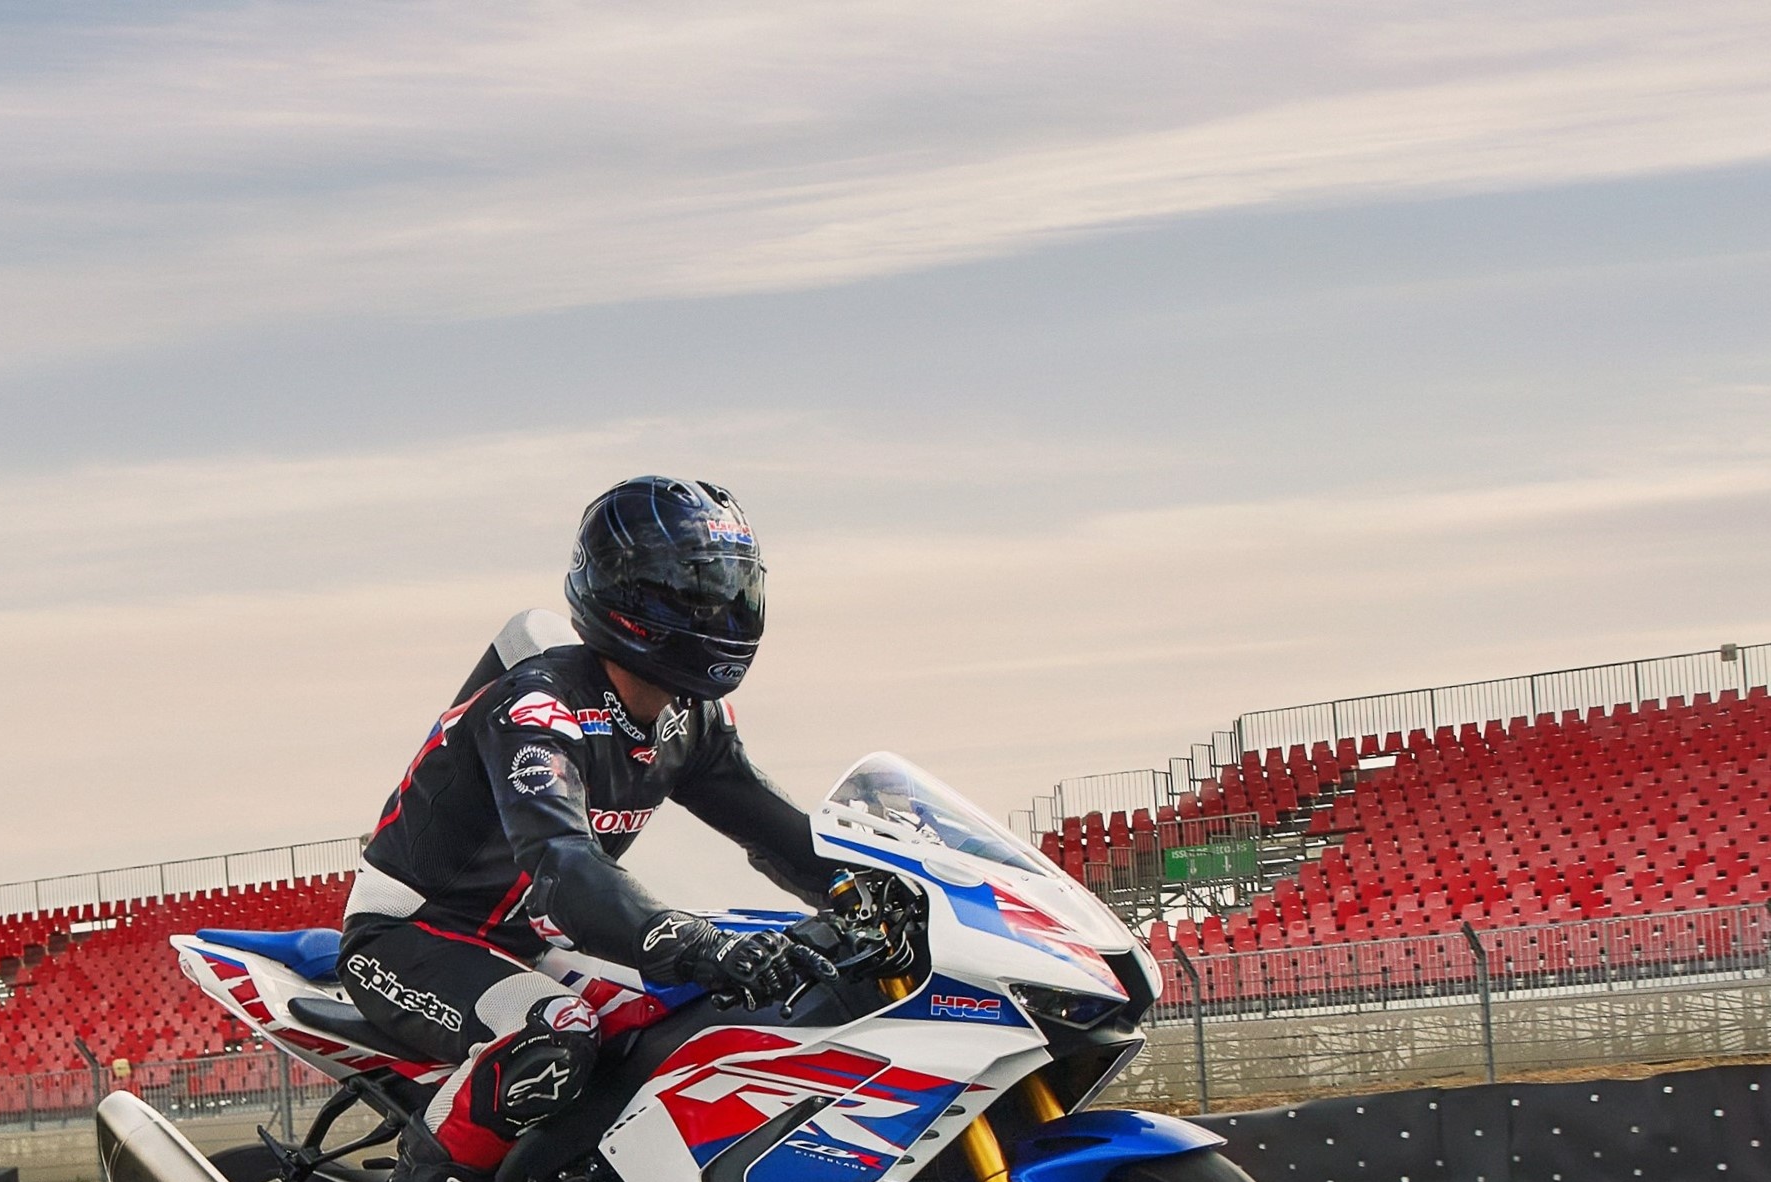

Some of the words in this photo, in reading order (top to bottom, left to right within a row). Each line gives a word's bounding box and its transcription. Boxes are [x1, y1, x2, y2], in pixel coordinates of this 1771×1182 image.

[347, 954, 463, 1032] alpinestars
[930, 994, 1001, 1020] HRC
[784, 1140, 884, 1170] CBR
[795, 1150, 868, 1171] FIREBLADE
